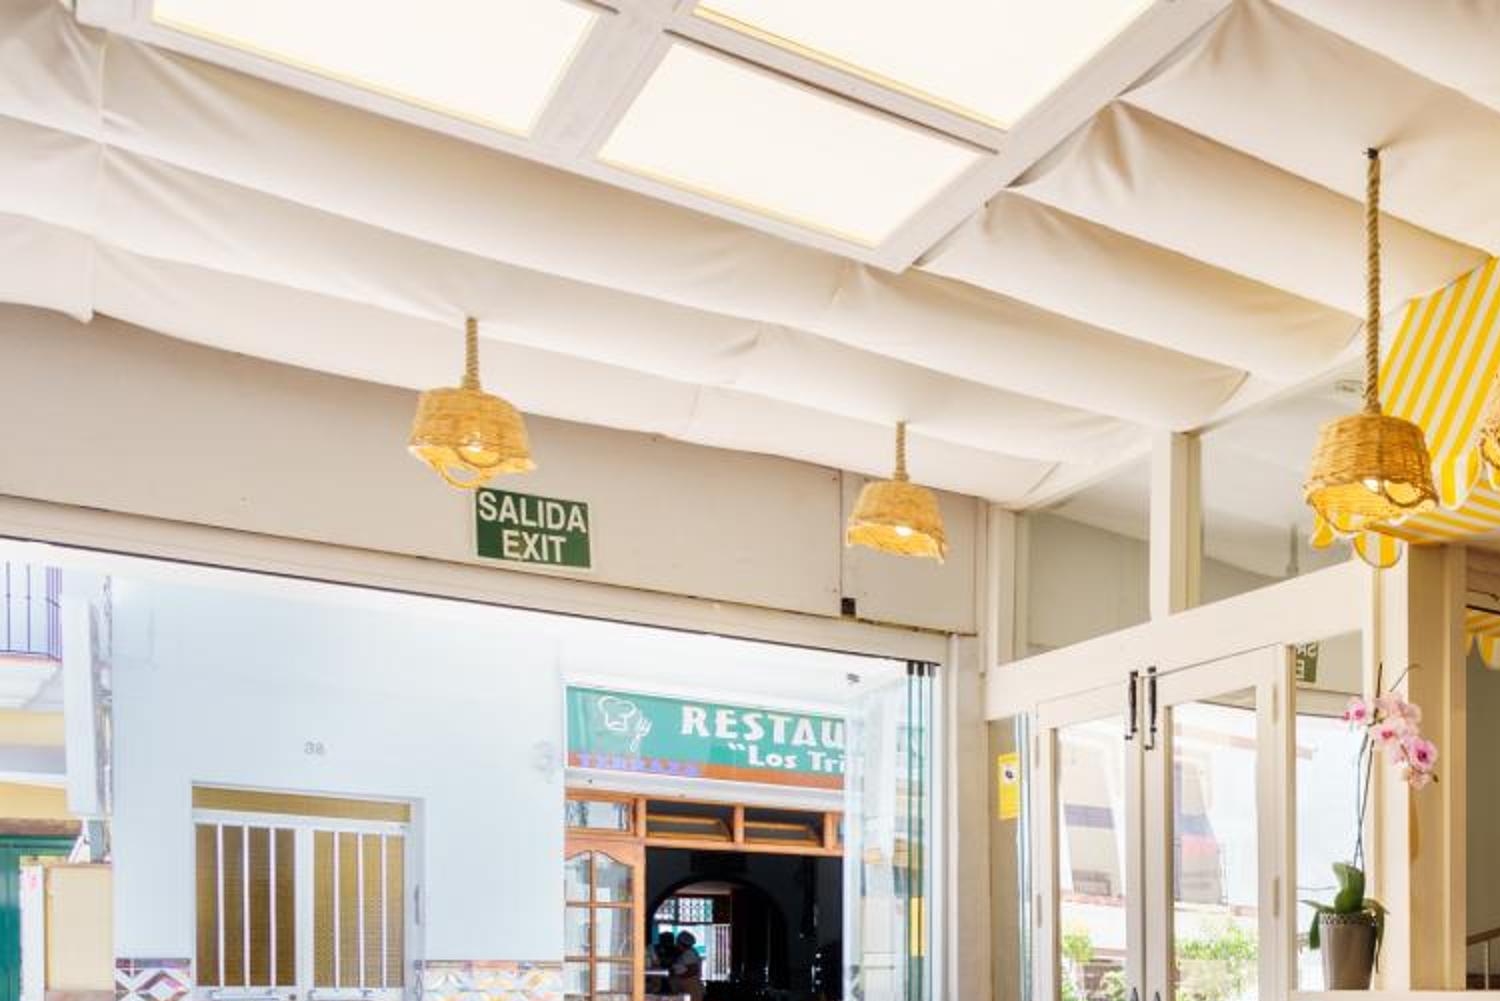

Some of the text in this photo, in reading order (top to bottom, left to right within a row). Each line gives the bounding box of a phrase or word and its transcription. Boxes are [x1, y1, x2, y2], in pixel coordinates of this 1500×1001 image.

[478, 490, 587, 534] SALIDA
[501, 528, 567, 563] EXIT
[681, 704, 844, 750] RESTAU
